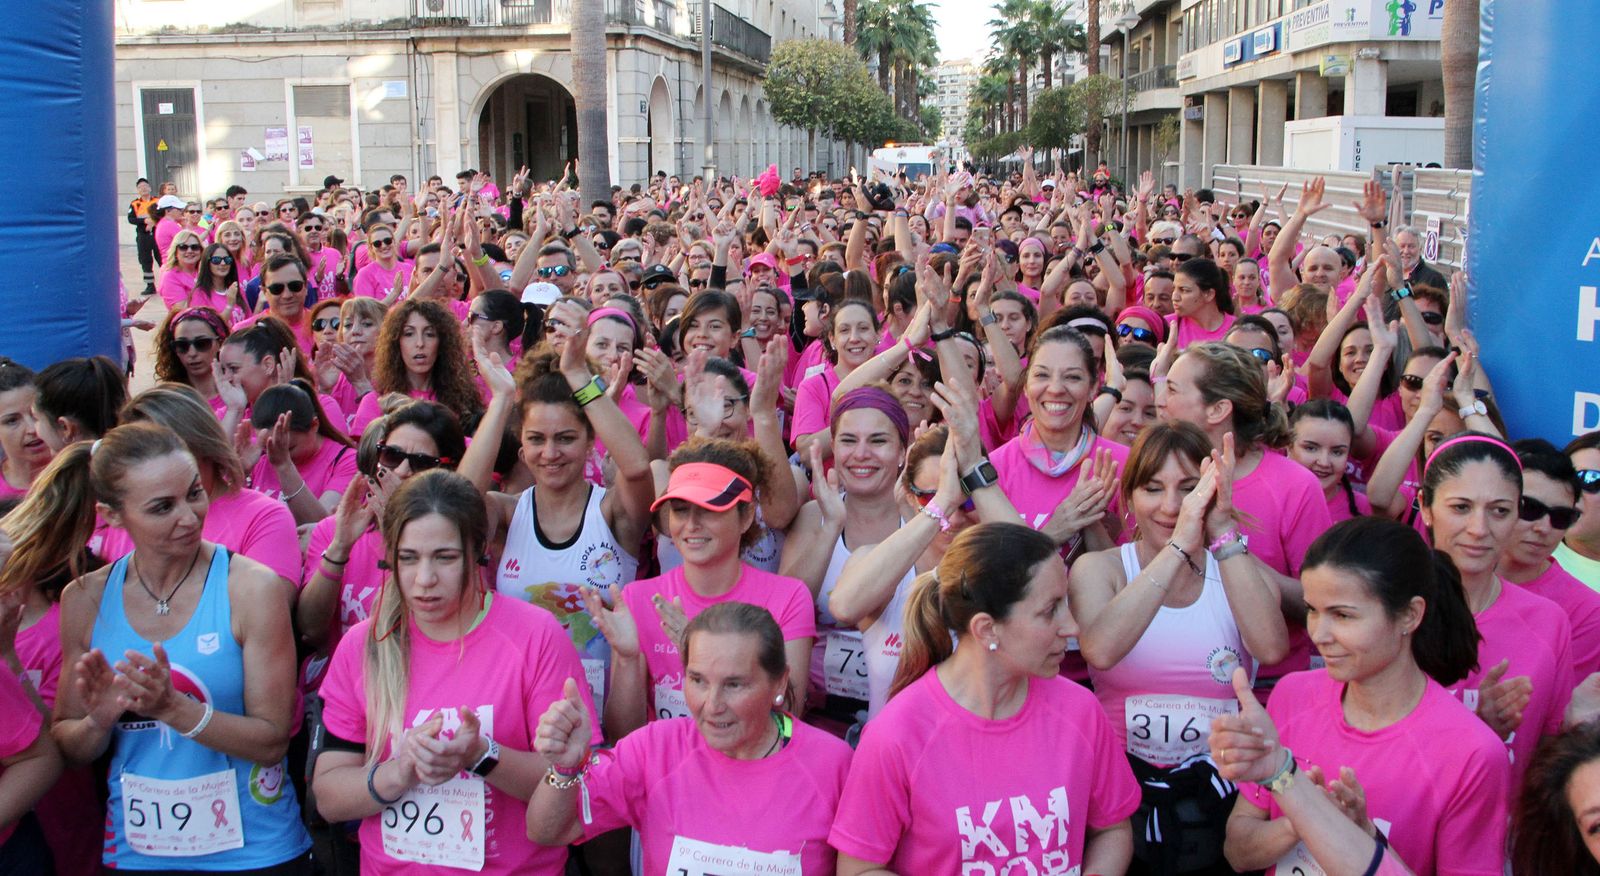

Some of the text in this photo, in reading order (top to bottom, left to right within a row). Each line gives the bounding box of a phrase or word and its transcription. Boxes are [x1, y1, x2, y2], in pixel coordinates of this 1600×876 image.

[1293, 4, 1329, 29] PREVENTIVA
[122, 722, 157, 730] CLUB
[1132, 714, 1201, 743] 316
[129, 798, 192, 831] 519
[956, 786, 1070, 861] KM
[693, 850, 733, 867] Carrera
[736, 859, 750, 869] de
[753, 862, 763, 871] la
[766, 864, 796, 876] Mujer
